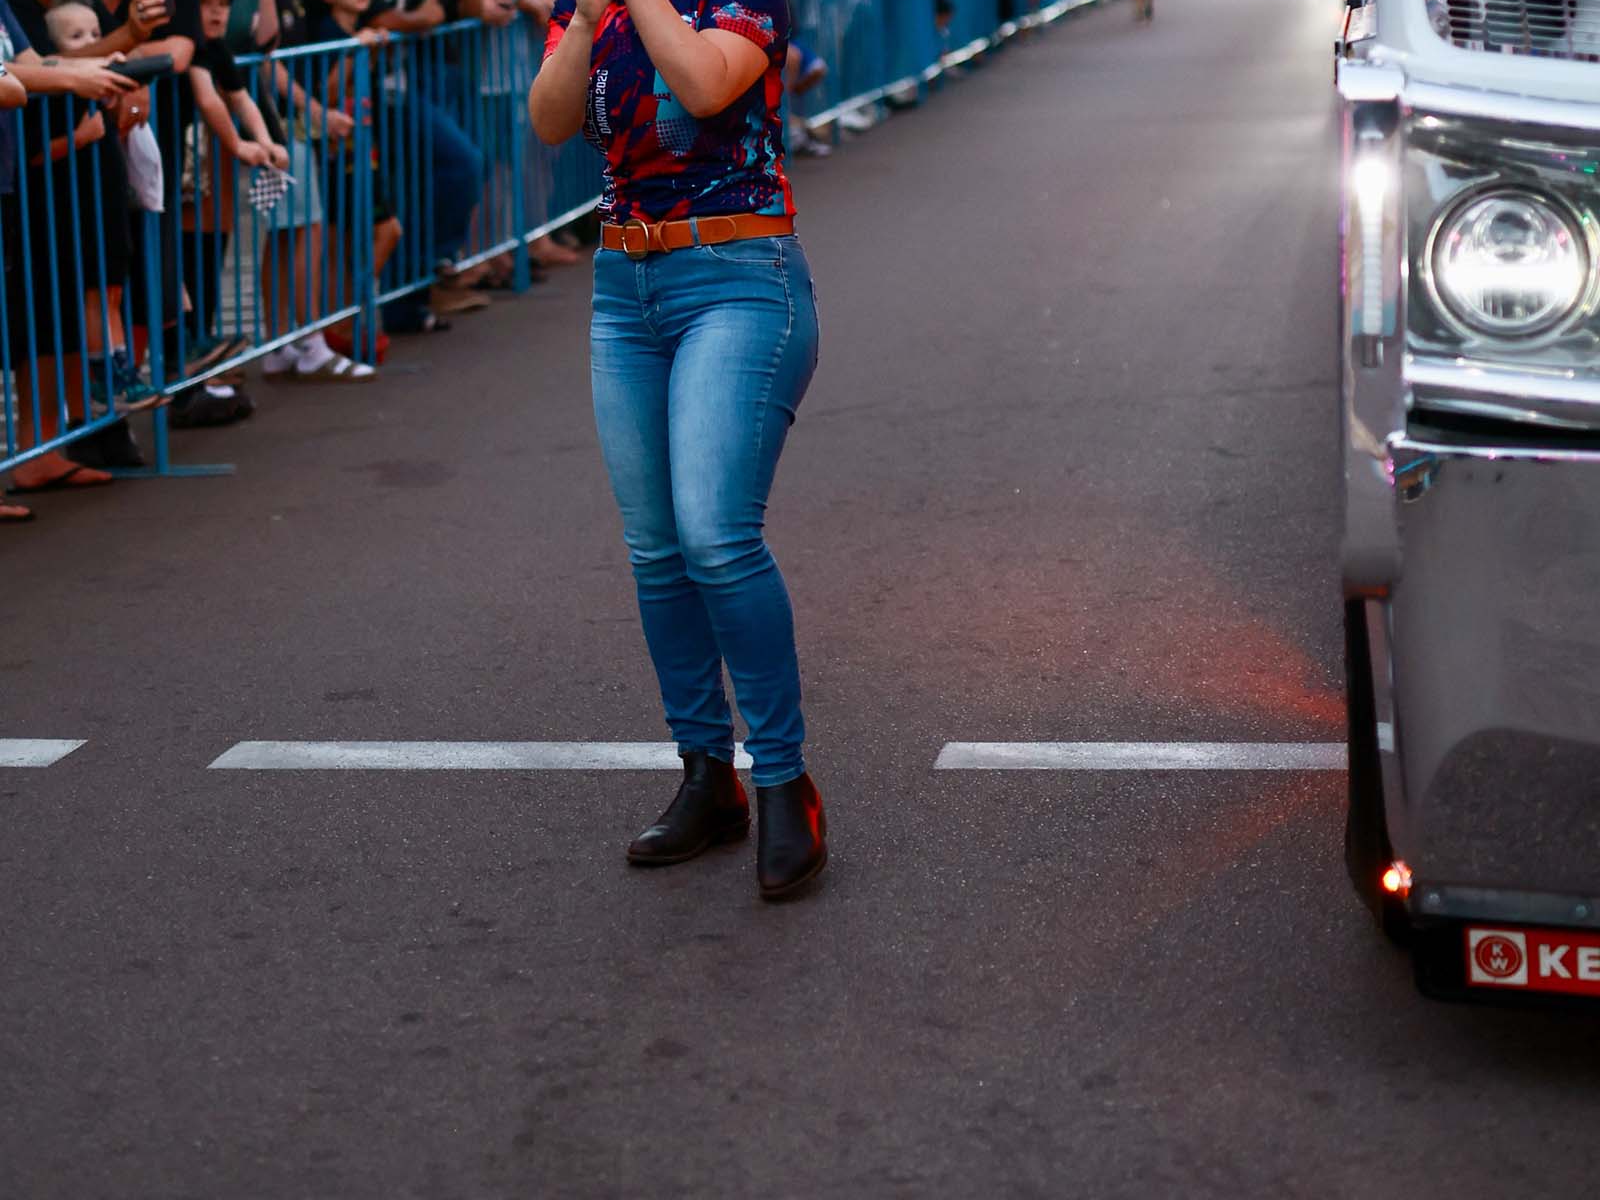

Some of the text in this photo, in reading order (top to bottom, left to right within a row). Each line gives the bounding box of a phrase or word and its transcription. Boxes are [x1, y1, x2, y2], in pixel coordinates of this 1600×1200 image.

[595, 69, 608, 95] 2026
[595, 96, 611, 134] DARWIN
[1538, 943, 1600, 981] KE
